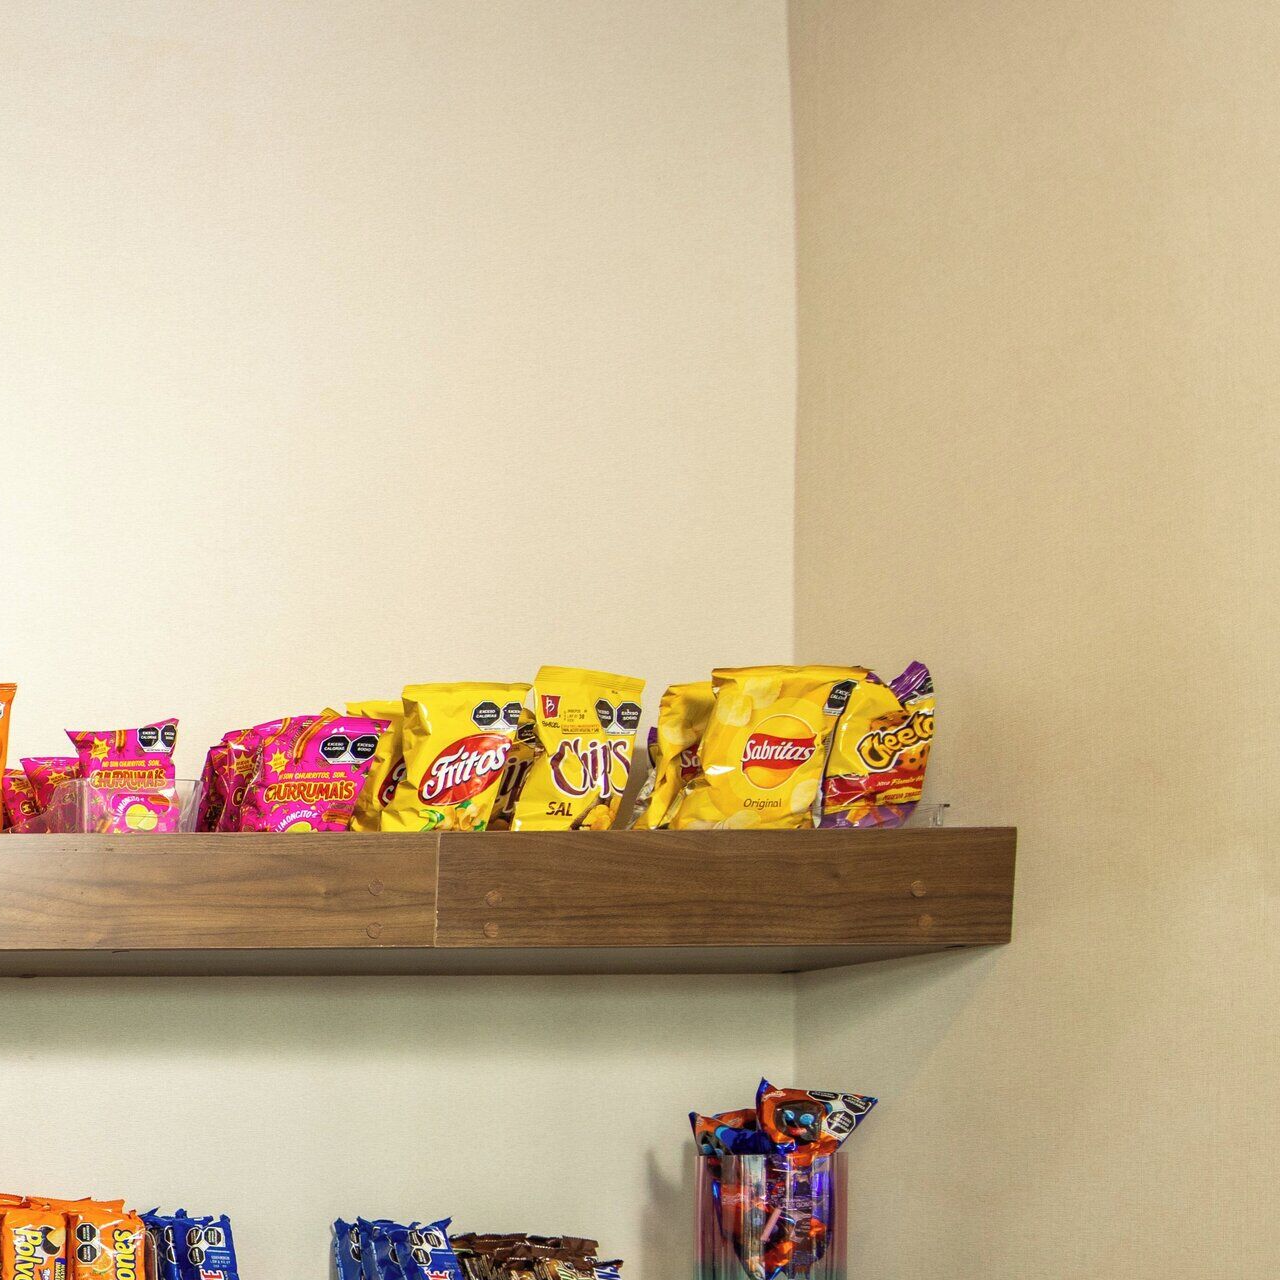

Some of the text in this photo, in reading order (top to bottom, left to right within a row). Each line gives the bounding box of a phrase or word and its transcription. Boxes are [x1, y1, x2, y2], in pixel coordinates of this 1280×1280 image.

[741, 740, 814, 762] Sabritas
[422, 743, 511, 800] Fritos
[546, 802, 573, 817] SAL
[743, 798, 782, 810] Original
